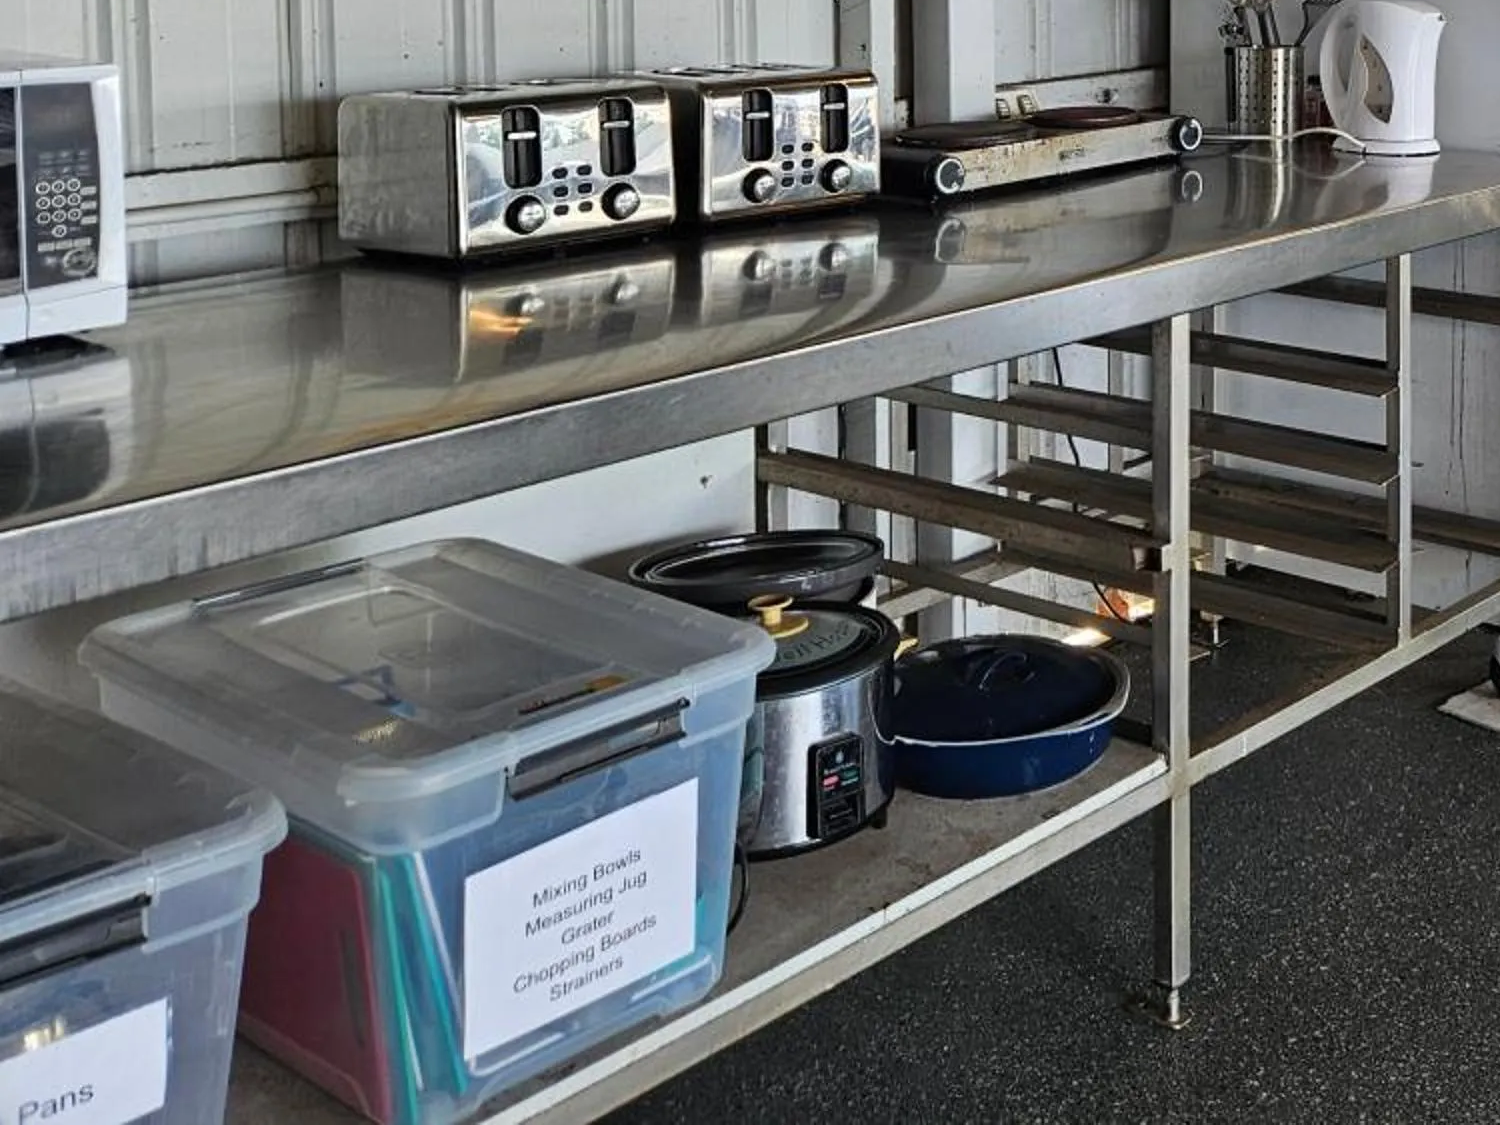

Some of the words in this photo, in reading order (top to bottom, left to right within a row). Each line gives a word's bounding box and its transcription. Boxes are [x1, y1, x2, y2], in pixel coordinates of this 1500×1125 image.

[525, 887, 614, 937] Measuring
[618, 871, 648, 894] Jug
[532, 873, 588, 908] Mixing
[593, 848, 641, 881] Bowls
[513, 945, 595, 993] Chopping
[600, 914, 657, 952] Boards
[561, 911, 615, 945] Grater
[549, 956, 623, 1001] Strainers
[19, 1083, 94, 1125] Pans
